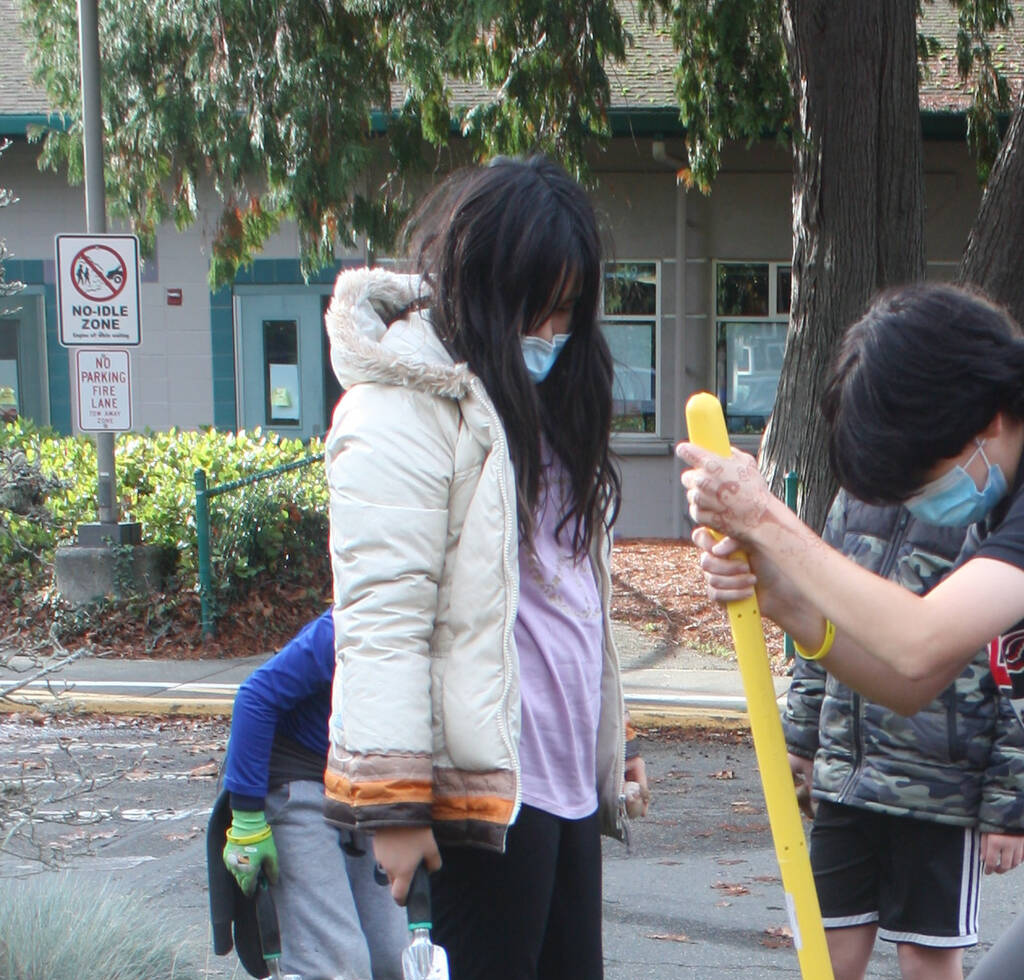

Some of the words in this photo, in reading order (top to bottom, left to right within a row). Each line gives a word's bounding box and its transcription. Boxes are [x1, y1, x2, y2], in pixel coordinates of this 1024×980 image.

[72, 305, 129, 316] NO-IDLE
[81, 318, 120, 330] ZONE
[96, 357, 111, 369] NO
[81, 371, 126, 383] PARKING
[92, 386, 116, 396] FIRE
[91, 398, 118, 408] LANE
